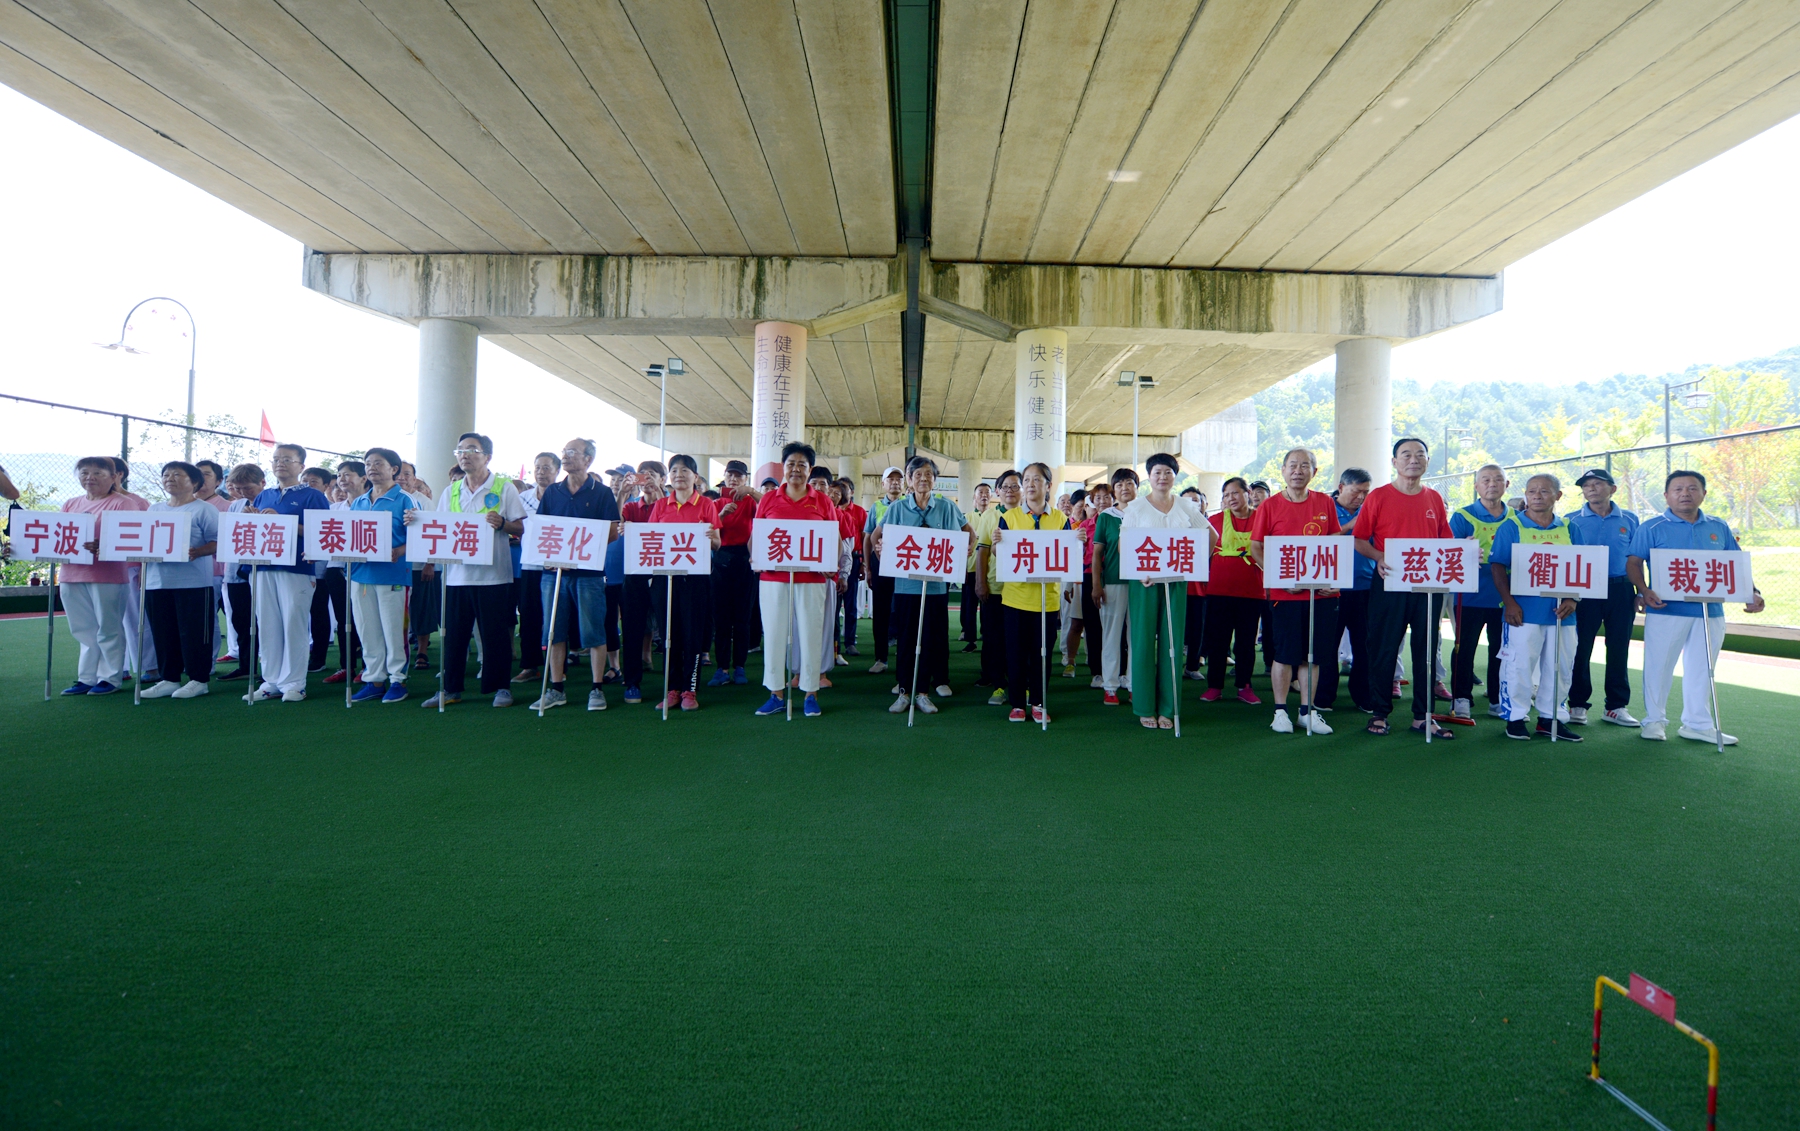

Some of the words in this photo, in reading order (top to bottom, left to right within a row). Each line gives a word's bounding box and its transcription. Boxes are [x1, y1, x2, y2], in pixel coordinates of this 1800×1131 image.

[771, 334, 792, 449] 健康在于锻炼
[1026, 343, 1047, 441] 快乐健康
[24, 519, 80, 555] 宁波
[114, 521, 175, 554] 三门
[231, 521, 286, 557] 镇海
[319, 518, 378, 554] 泰顺
[421, 520, 480, 557] 宁海
[537, 524, 595, 562] 奉化
[639, 531, 697, 567] 嘉兴
[767, 527, 823, 563] 象山
[896, 534, 954, 574] 余姚
[1011, 537, 1069, 574] 舟山
[1135, 536, 1195, 574] 金塘
[1279, 544, 1339, 581] 鄞州
[1402, 547, 1465, 584] 慈溪
[1528, 551, 1592, 589] 衢山
[1668, 558, 1736, 595] 裁判
[1645, 985, 1656, 1004] 2
